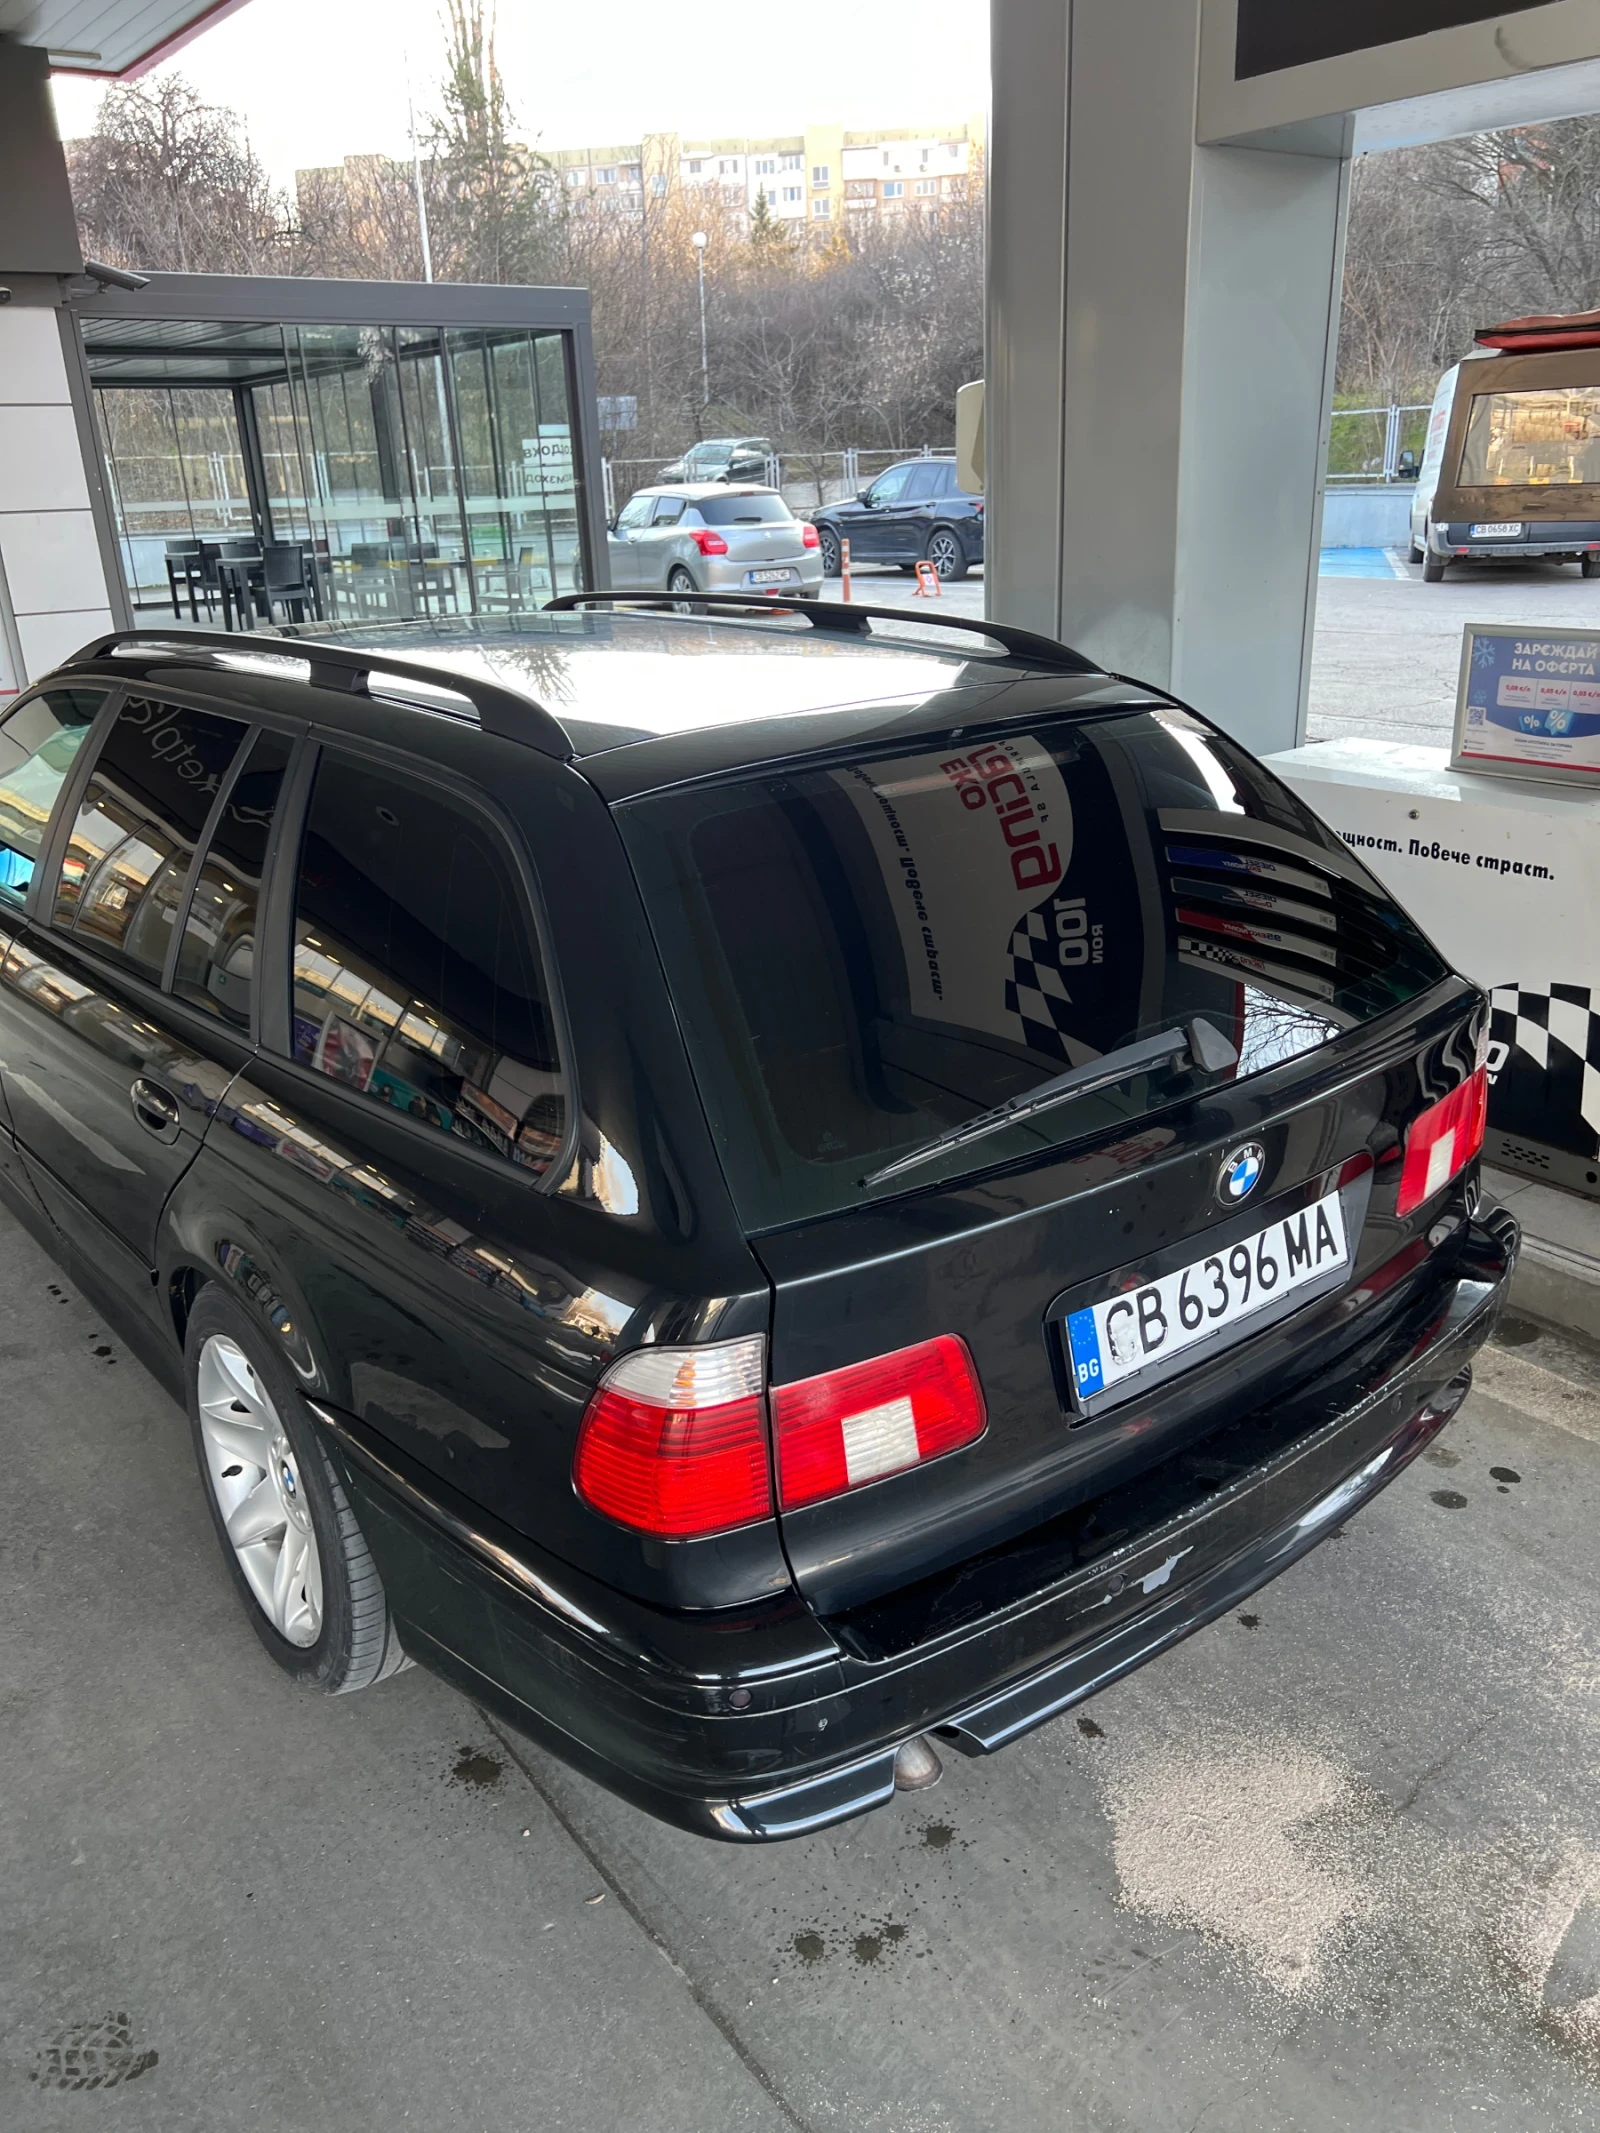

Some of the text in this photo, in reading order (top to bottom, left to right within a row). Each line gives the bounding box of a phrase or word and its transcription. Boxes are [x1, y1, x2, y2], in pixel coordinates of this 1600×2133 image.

[1512, 658, 1531, 671] НА
[1335, 830, 1555, 881] щност. Повече страст.
[1227, 1146, 1265, 1173] BMW
[1177, 1230, 1279, 1331] 6396
[1282, 1203, 1339, 1279] MA
[1077, 1358, 1100, 1383] BG
